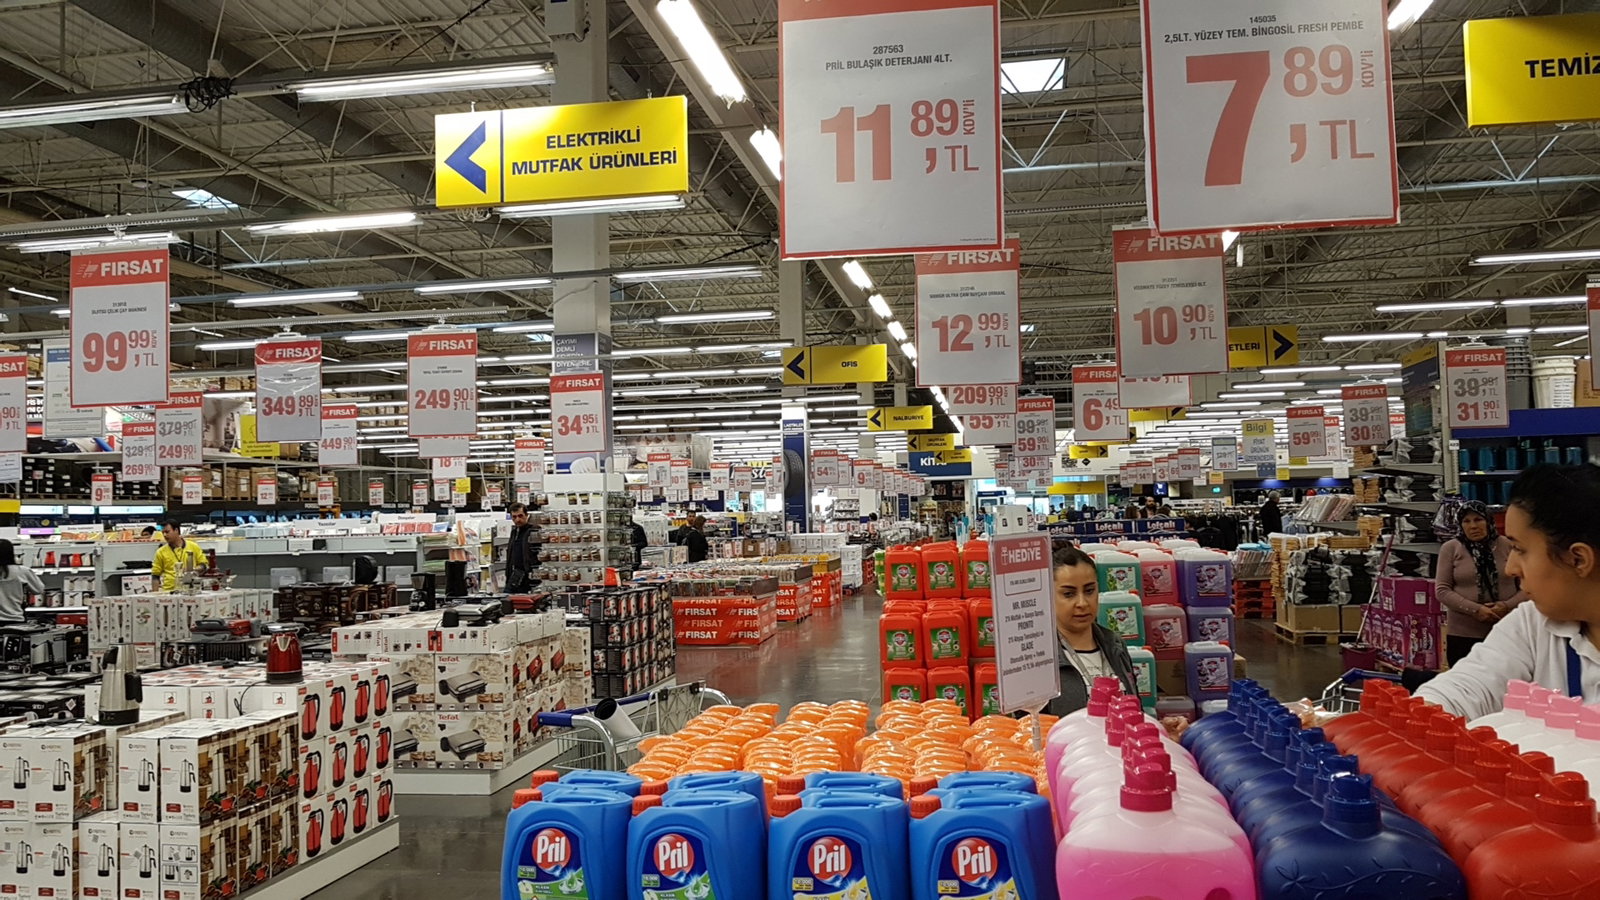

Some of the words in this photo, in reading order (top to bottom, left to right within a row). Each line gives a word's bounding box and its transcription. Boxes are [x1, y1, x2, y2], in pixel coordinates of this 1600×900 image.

[1249, 15, 1277, 24] 145035
[1164, 32, 1192, 43] 2,5LT.
[1194, 30, 1224, 41] YÜZEY
[1227, 29, 1250, 39] TEM.
[1251, 25, 1296, 37] BİNGOSİL
[1297, 22, 1329, 34] FRESH
[1331, 20, 1364, 32] PEMBE
[873, 45, 904, 54] 287563
[825, 59, 845, 71] PRİL
[847, 58, 884, 70] BULAŞIK
[885, 56, 932, 67] DETERJANI
[934, 54, 953, 64] 4LT.
[1525, 52, 1600, 78] TEMİZ
[1195, 50, 1280, 187] 7
[1292, 43, 1364, 98] 89
[546, 132, 641, 155] ELEKTRİKLİ
[820, 104, 892, 183] 11
[910, 98, 969, 138] 89
[511, 164, 583, 182] MUTFAK
[589, 153, 678, 176] ÜRÜNLERİ
[101, 258, 163, 277] FIRSAT
[1133, 305, 1177, 345] 10
[1182, 303, 1207, 323] 90
[931, 314, 973, 352] 12
[977, 312, 1002, 331] 99
[83, 331, 127, 373] 99
[128, 329, 150, 349] 99
[275, 347, 318, 358] FIRSAT
[429, 339, 474, 351] FIRSAT
[1229, 342, 1260, 352] ETLERİ
[841, 360, 858, 368] OFİS
[1464, 353, 1503, 362] FIRSAT
[1089, 370, 1117, 379] FIRSA
[566, 378, 601, 387] FIRSAT
[415, 389, 451, 410] 249
[453, 388, 468, 401] 90
[953, 386, 987, 405] 209
[1354, 388, 1385, 396] FIRSAT
[171, 396, 201, 404] FIRSAT
[262, 395, 296, 417] 349
[299, 395, 314, 408] 89
[329, 408, 355, 416] FIRSAT
[1082, 398, 1103, 431] 6
[1456, 402, 1480, 422] 31
[1483, 400, 1496, 410] 90
[159, 421, 182, 436] 379
[557, 415, 582, 436] 34
[582, 413, 595, 424] 95
[1246, 422, 1267, 434] Bilgi
[1293, 431, 1311, 445] 59
[1350, 425, 1370, 441] 30
[321, 438, 342, 450] 449
[1017, 437, 1036, 452] 59
[159, 445, 182, 459] 249
[518, 461, 532, 473] 28
[920, 455, 947, 467] KİT
[1008, 547, 1041, 564] HEDİYE
[685, 608, 717, 616] FIRSAT
[738, 608, 758, 616] FIRS
[691, 619, 724, 627] FIRSAT
[685, 631, 718, 639] FIRSAT
[738, 631, 760, 639] FIRS
[438, 655, 460, 663] Tefal
[536, 835, 566, 864] Pril
[658, 840, 688, 871] Pril
[813, 844, 846, 874] Pril
[957, 845, 992, 876] Pril
